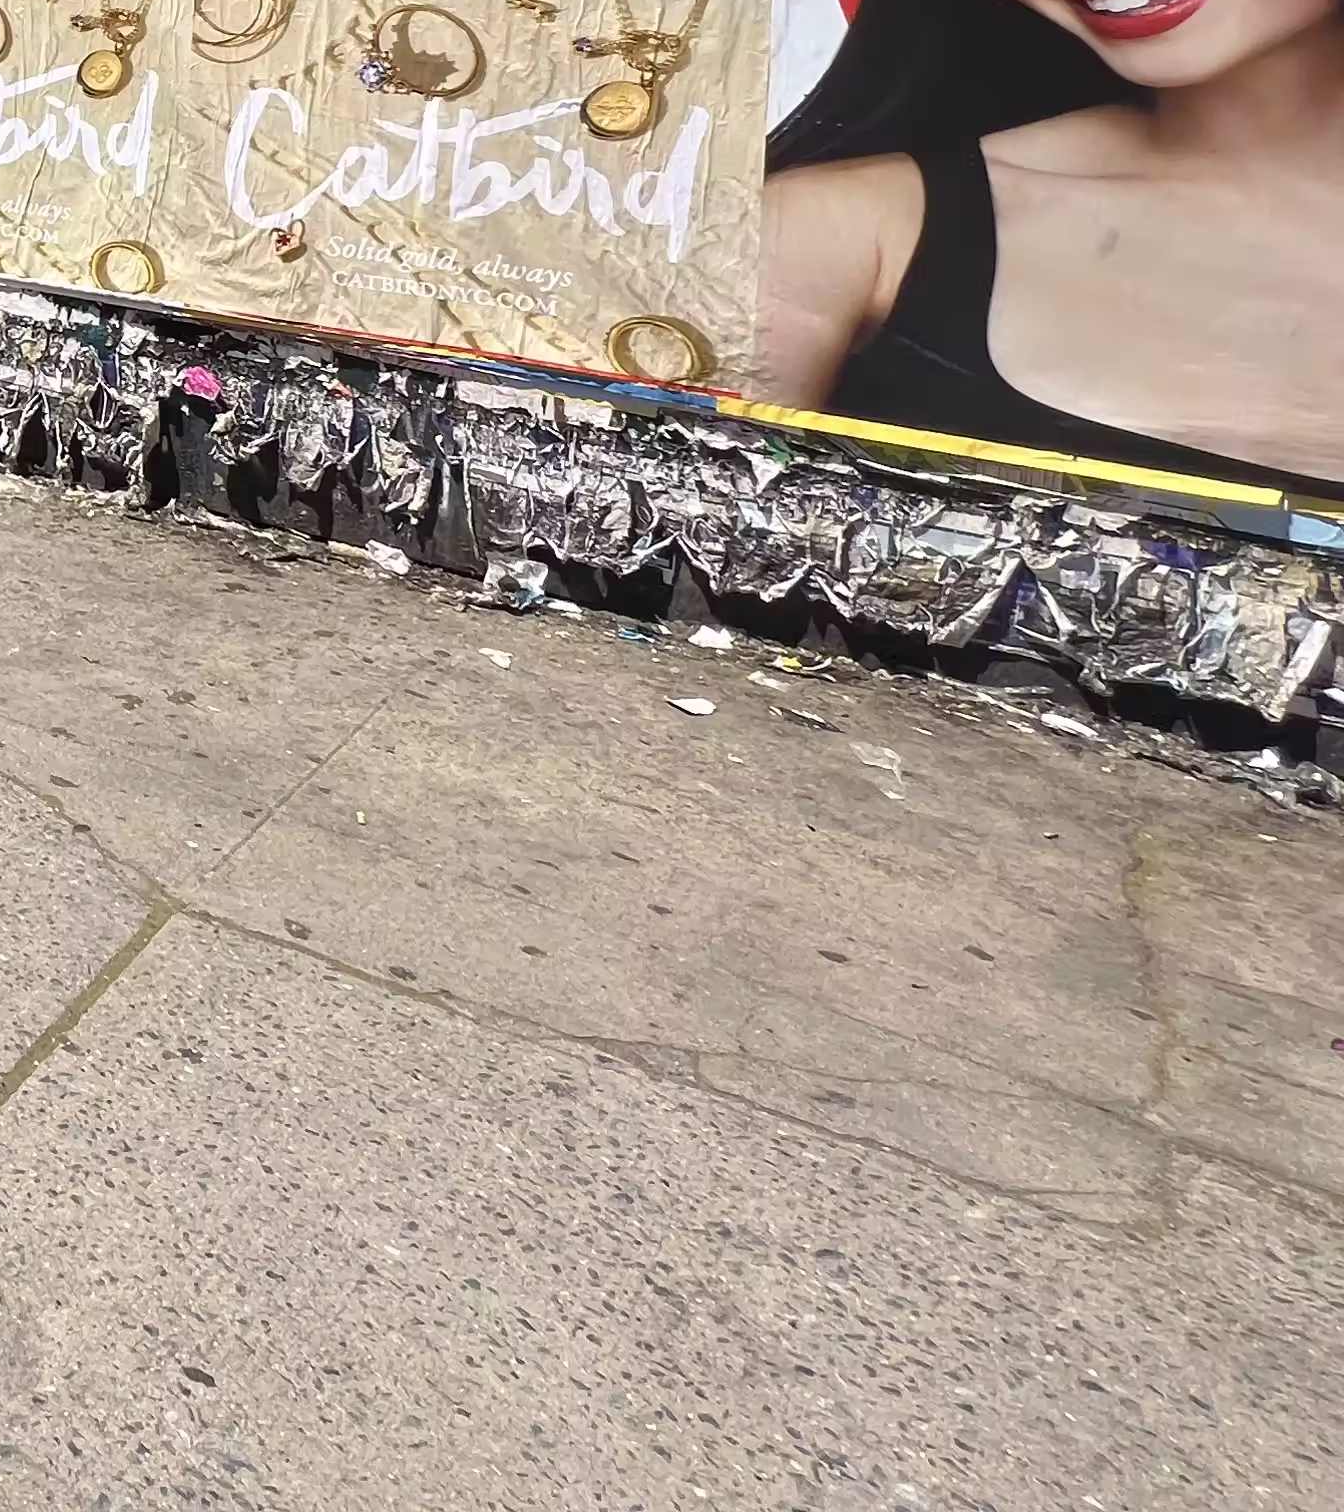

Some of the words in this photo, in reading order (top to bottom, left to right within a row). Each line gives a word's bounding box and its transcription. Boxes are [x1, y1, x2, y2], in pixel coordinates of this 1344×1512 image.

[223, 88, 710, 265] Catbird
[0, 194, 73, 225] always
[325, 236, 395, 264] Solid
[396, 246, 463, 275] gold,
[472, 254, 574, 292] always
[332, 270, 560, 317] CATBIRDNYC.COM
